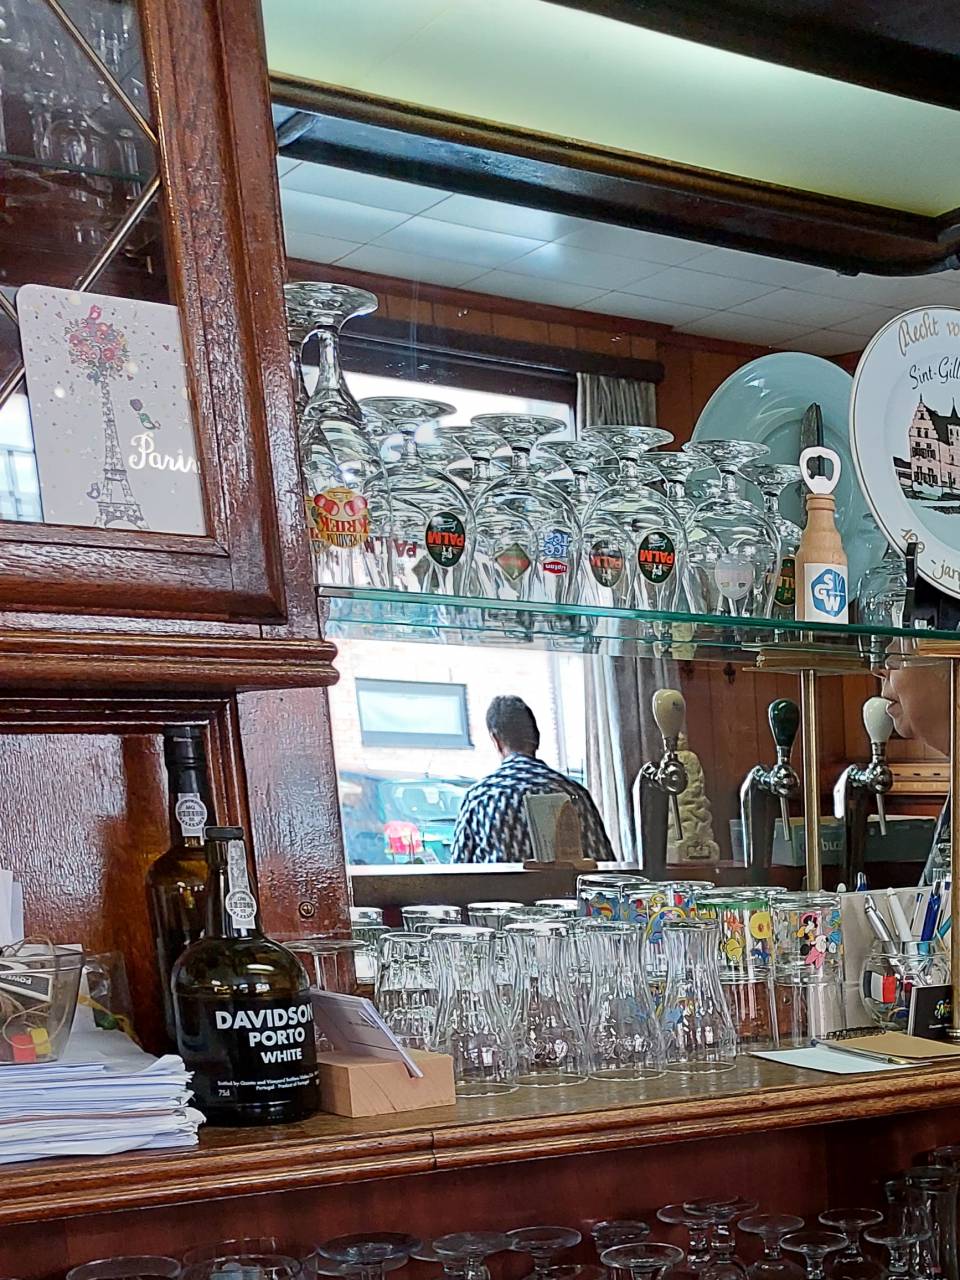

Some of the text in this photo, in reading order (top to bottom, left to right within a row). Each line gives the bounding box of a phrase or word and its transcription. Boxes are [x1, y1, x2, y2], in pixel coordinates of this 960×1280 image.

[428, 531, 465, 546] PALM
[640, 549, 674, 565] PALM
[215, 1002, 314, 1029] DAVIDSON
[248, 1027, 305, 1047] PORTO
[260, 1048, 303, 1064] WHITE
